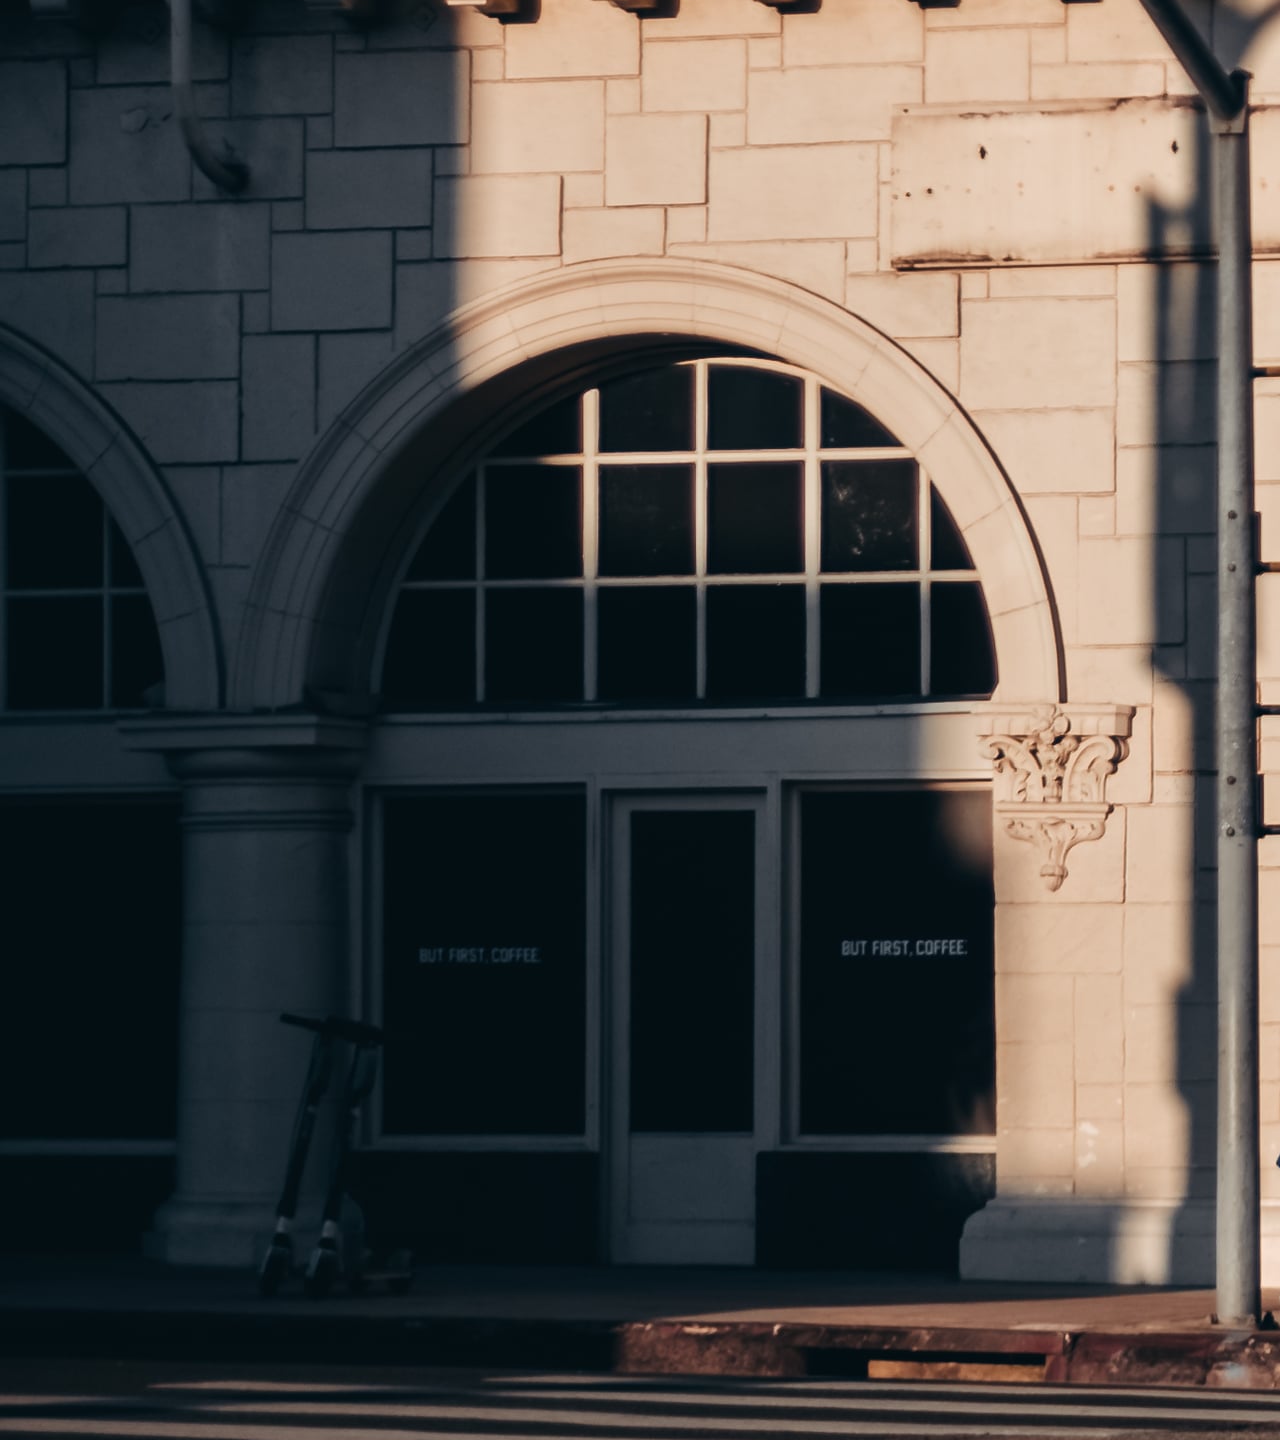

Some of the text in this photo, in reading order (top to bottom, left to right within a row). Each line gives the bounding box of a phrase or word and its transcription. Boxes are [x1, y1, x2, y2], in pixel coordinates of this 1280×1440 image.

[418, 947, 444, 964] BUT
[841, 939, 868, 957] BUT
[871, 939, 913, 958] FIRST,
